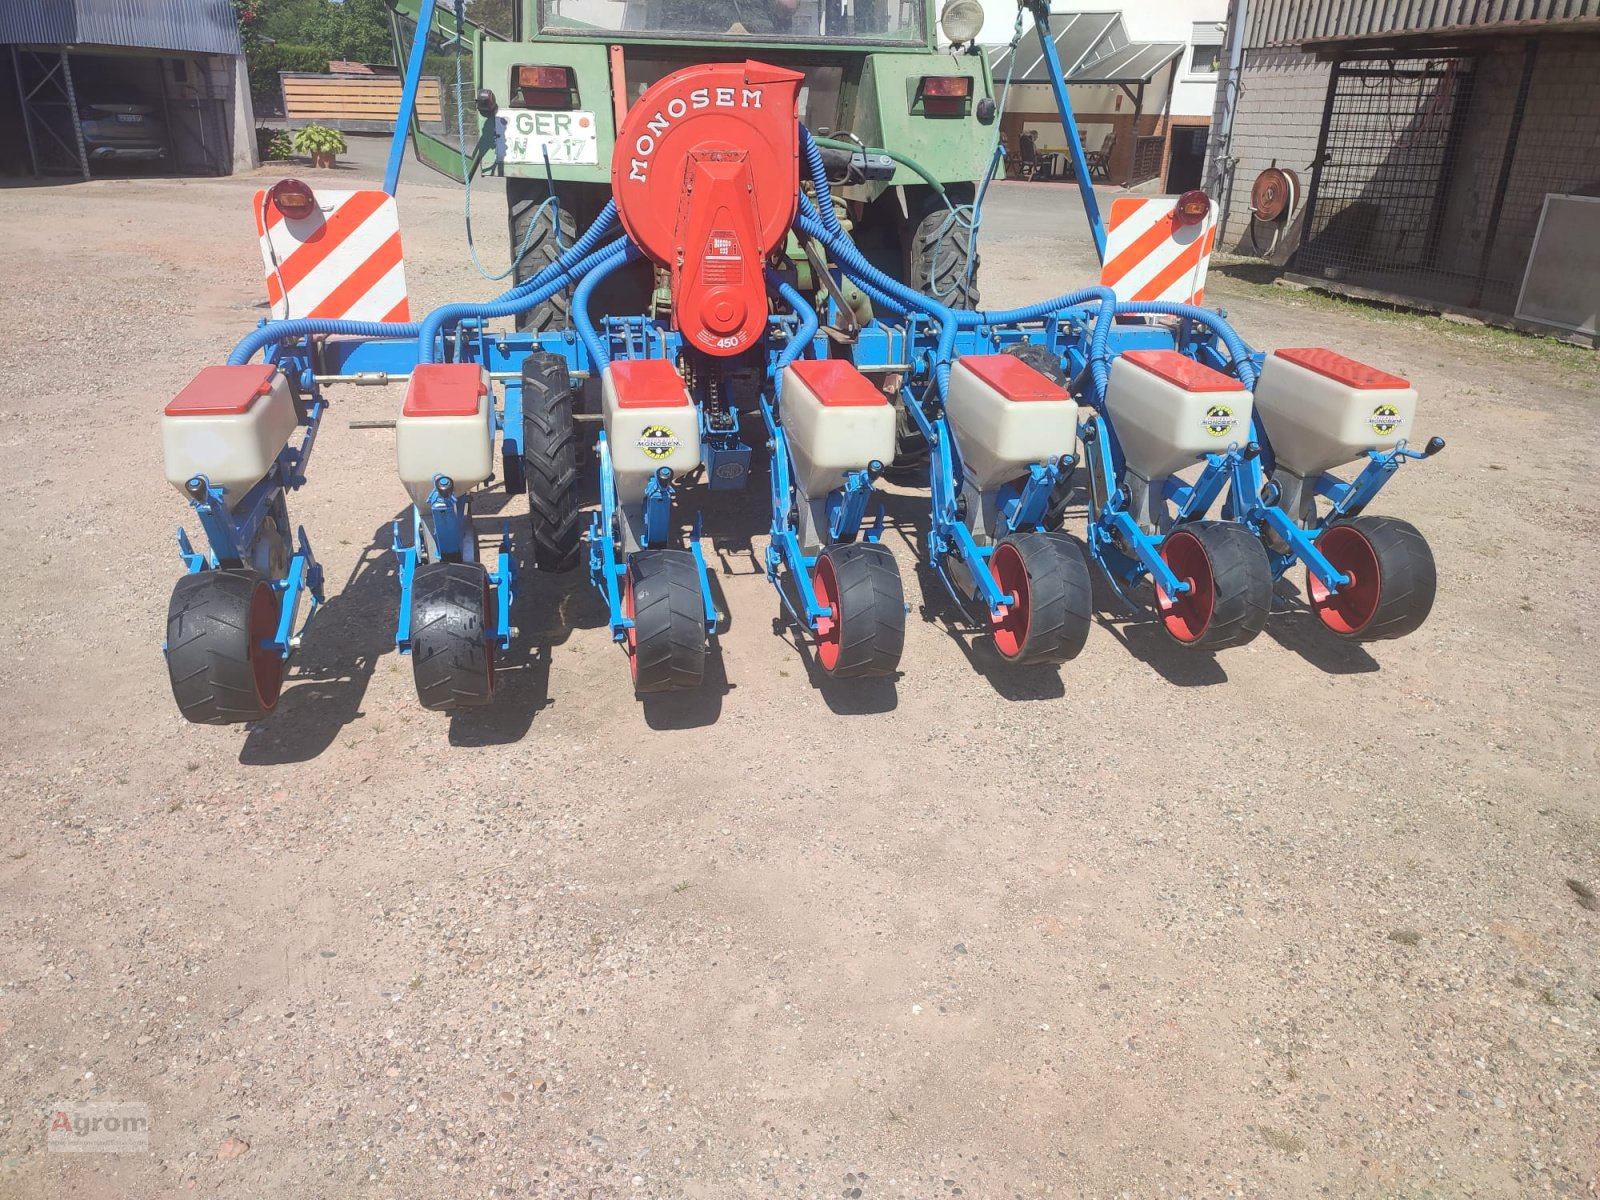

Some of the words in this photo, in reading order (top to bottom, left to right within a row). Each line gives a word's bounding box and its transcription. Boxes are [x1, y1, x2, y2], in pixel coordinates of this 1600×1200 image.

[516, 113, 572, 136] GER
[629, 87, 763, 183] MONOSEM
[547, 139, 586, 160] 217
[716, 337, 739, 348] 450
